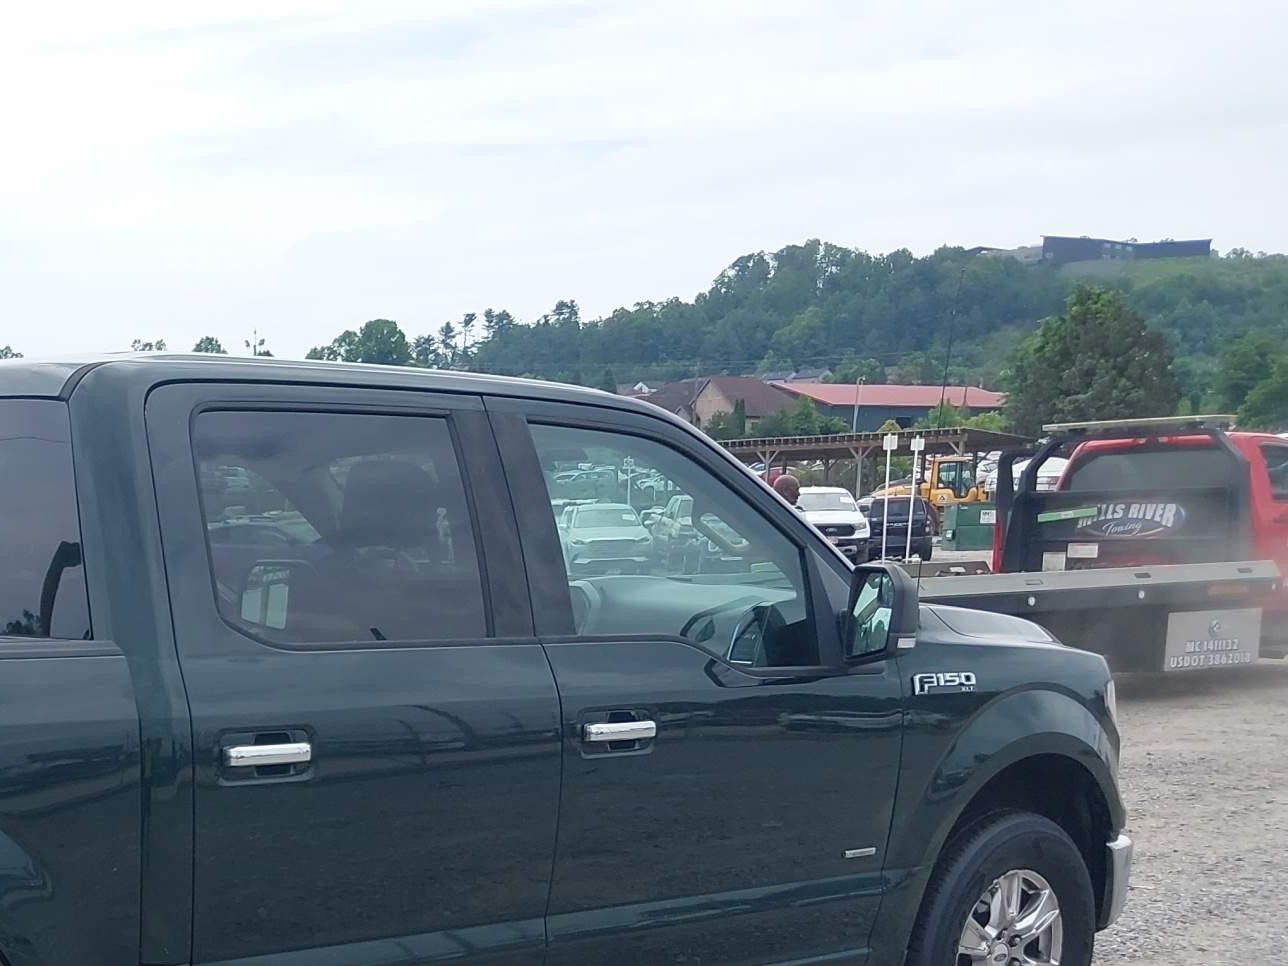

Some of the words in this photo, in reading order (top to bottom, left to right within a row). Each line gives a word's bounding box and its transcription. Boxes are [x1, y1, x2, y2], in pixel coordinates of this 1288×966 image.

[1128, 503, 1177, 528] RIVER
[1102, 521, 1142, 537] Towing
[1170, 655, 1205, 668] USDOT
